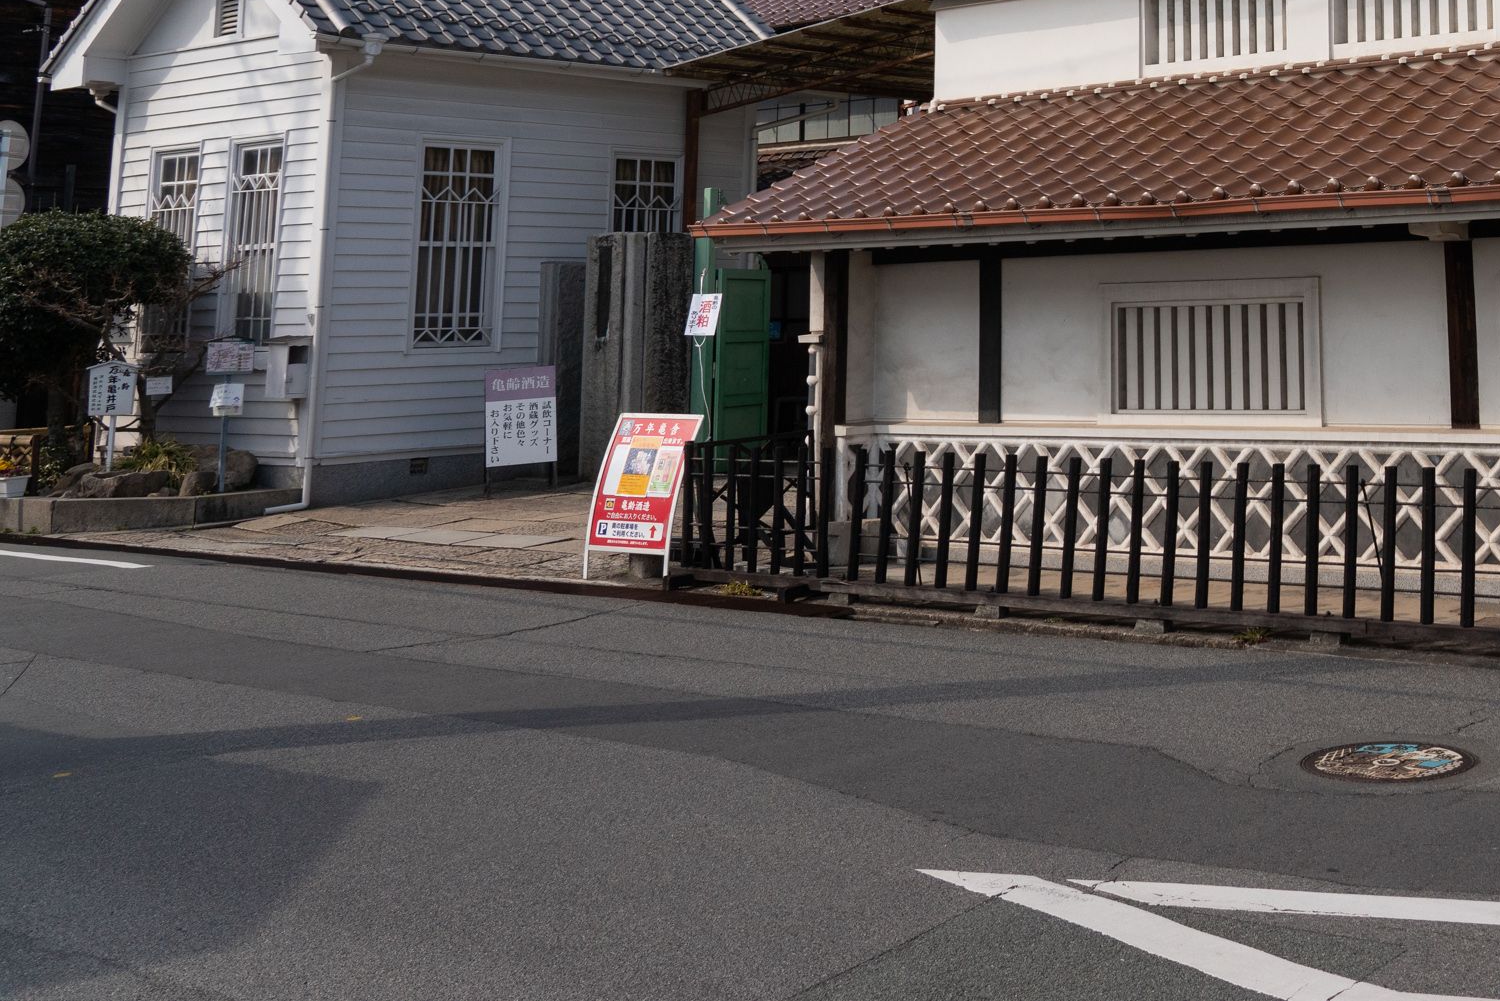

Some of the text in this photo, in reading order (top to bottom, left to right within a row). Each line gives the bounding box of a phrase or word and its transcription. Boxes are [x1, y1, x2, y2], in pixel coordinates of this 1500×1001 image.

[696, 301, 712, 328] 酒粕
[492, 375, 550, 392] 亀齢酒造
[490, 410, 499, 463] お入り下さい
[503, 404, 512, 439] お気軽に
[515, 402, 525, 447] その他色々
[528, 402, 539, 447] 酒蔵グッズ
[542, 401, 552, 454] 試飲コーナー
